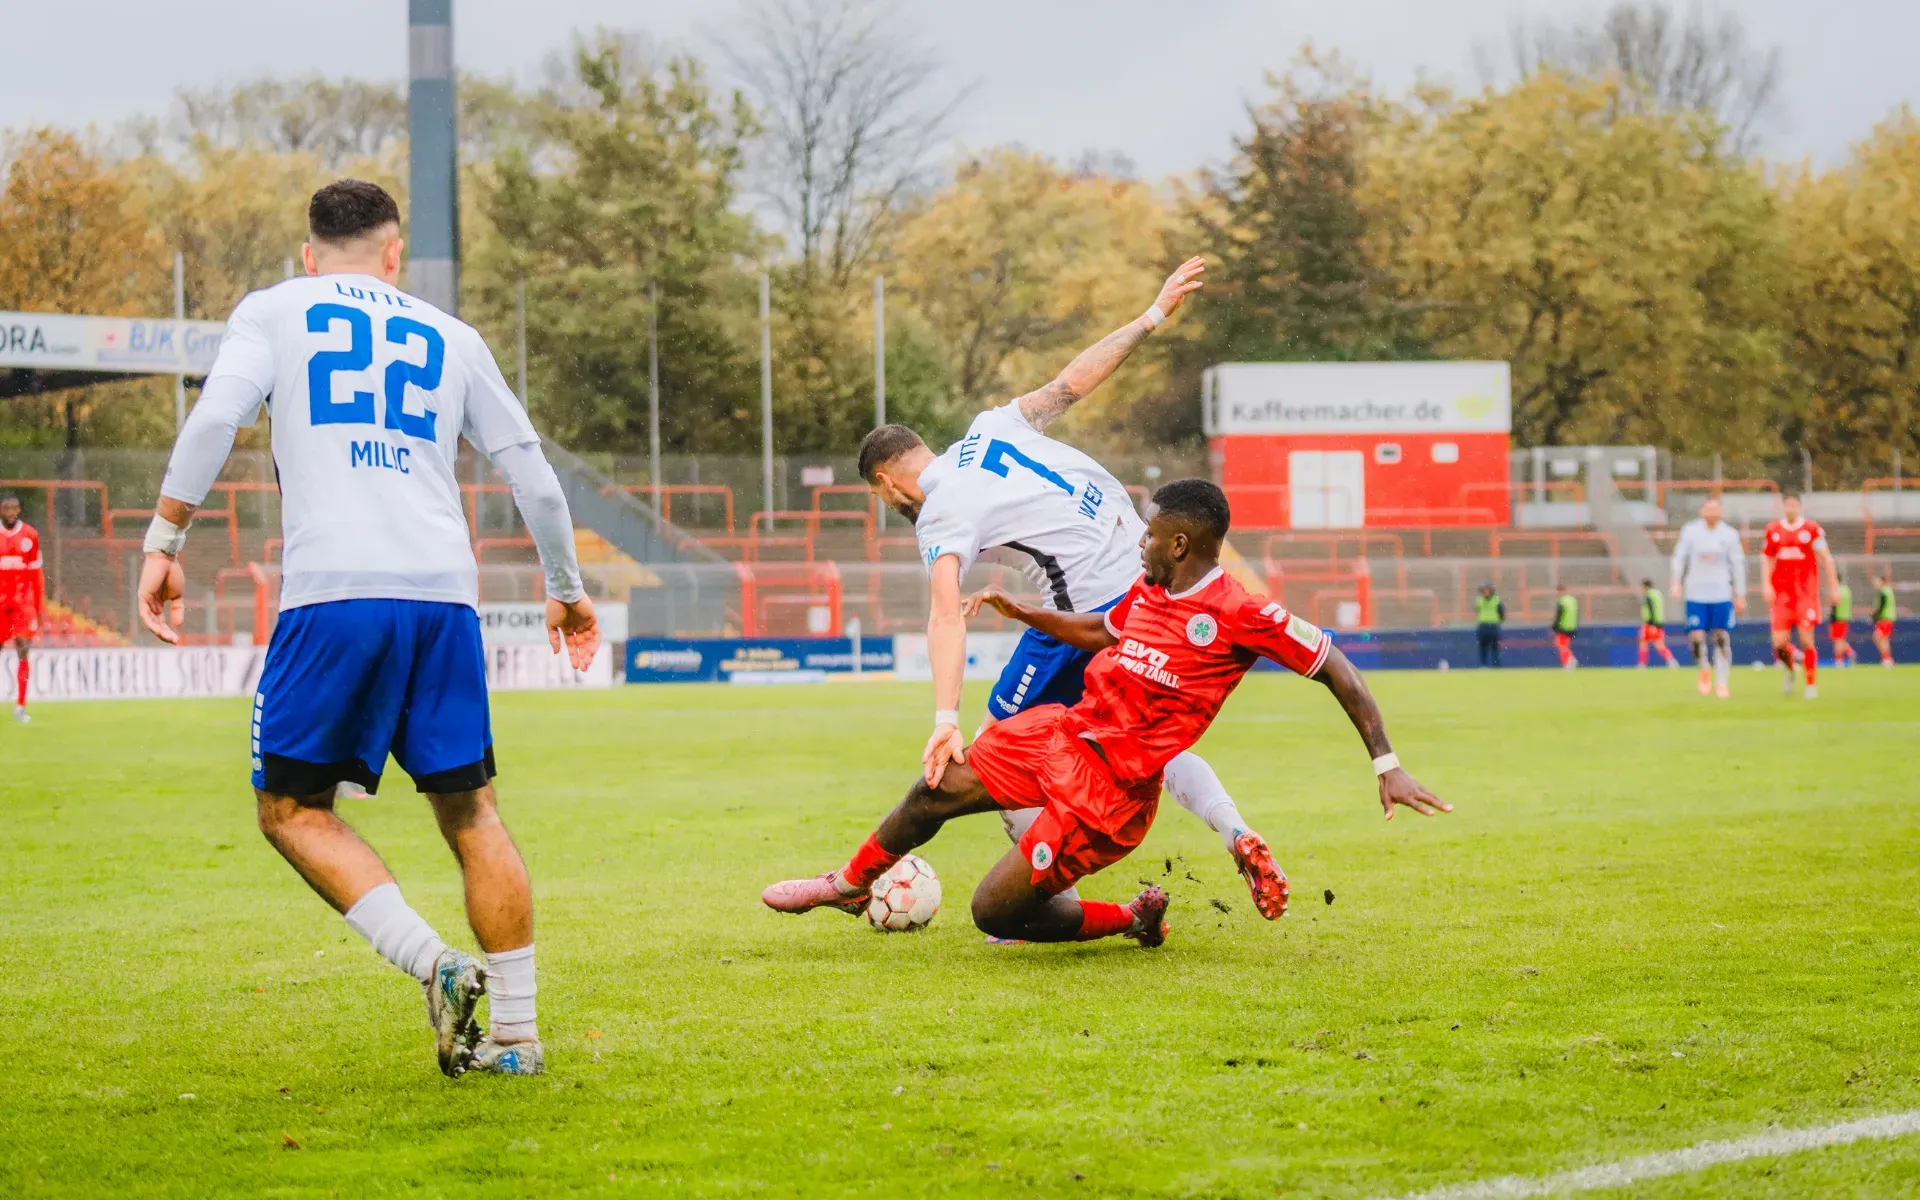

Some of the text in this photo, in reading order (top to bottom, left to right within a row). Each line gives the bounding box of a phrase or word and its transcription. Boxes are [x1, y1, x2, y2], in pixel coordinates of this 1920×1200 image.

[335, 282, 412, 308] LOTTE
[305, 302, 445, 443] 22
[1231, 401, 1443, 422] Kaffeemacher.de
[351, 440, 410, 474] MILIC
[957, 433, 981, 468] OTTE
[980, 438, 1075, 496] 7
